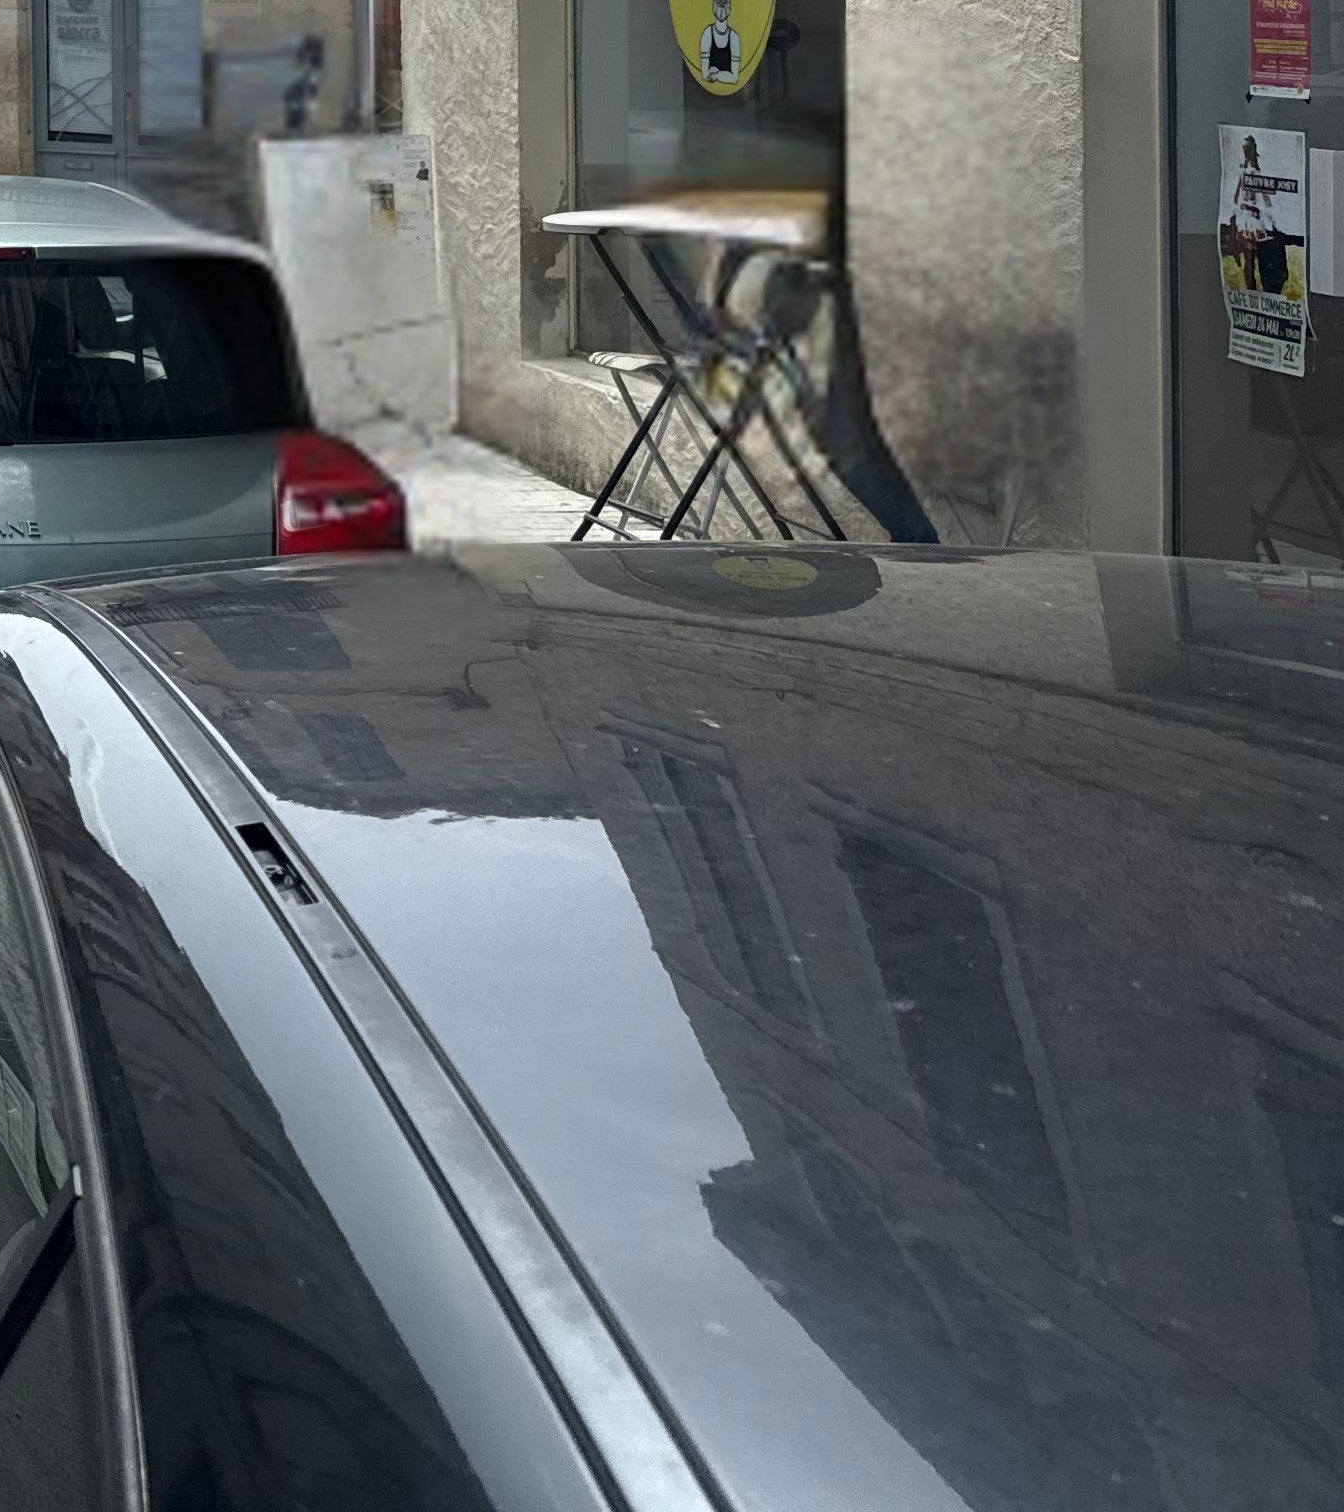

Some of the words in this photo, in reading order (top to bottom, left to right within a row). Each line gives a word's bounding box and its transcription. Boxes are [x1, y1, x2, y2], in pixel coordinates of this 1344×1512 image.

[1245, 176, 1275, 188] PAUVRE
[1277, 181, 1296, 191] JOSY
[1261, 297, 1302, 318] COMMERCE
[1266, 318, 1279, 336] MAI
